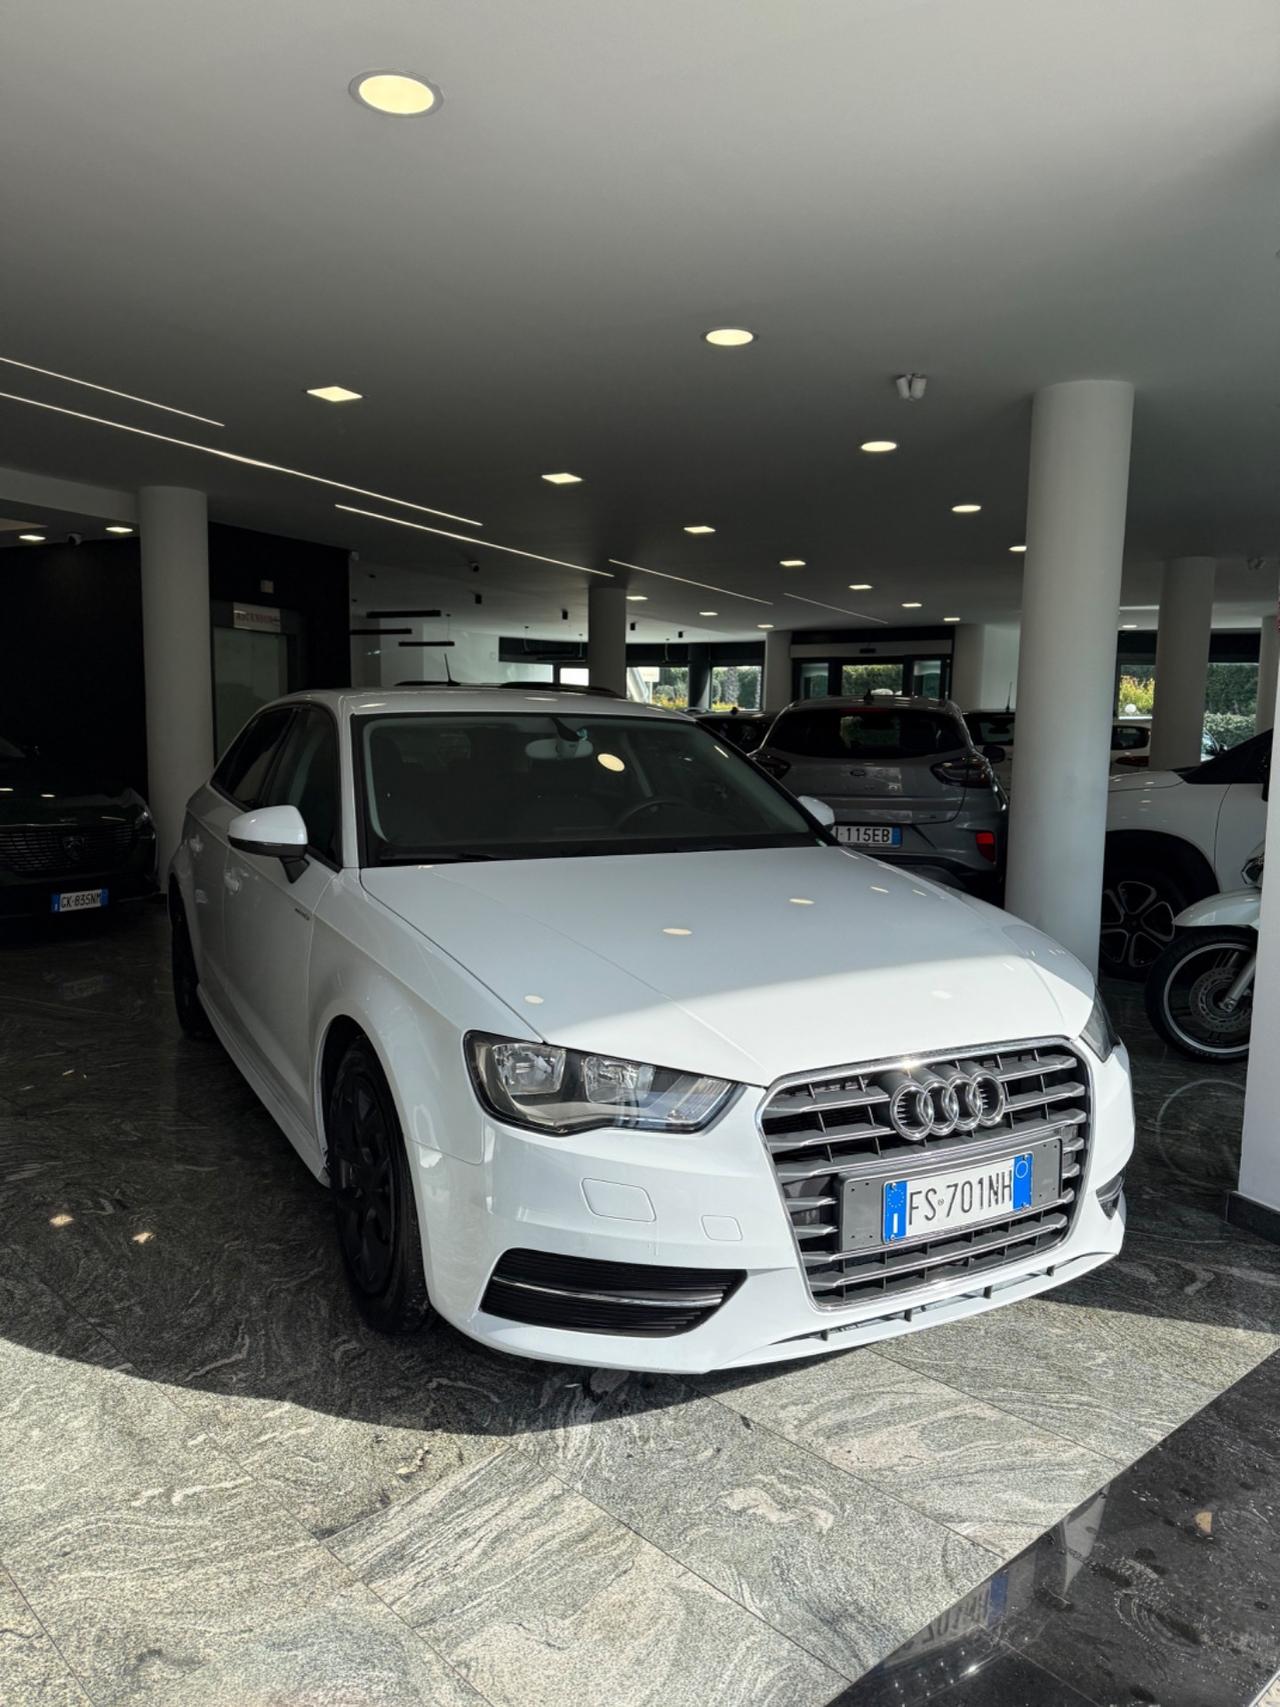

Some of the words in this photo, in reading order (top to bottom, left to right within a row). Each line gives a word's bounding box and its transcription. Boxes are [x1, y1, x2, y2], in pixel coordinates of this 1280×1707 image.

[847, 828, 890, 842] 115EB
[908, 1188, 937, 1226] FS
[946, 1170, 1012, 1218] 701NH
